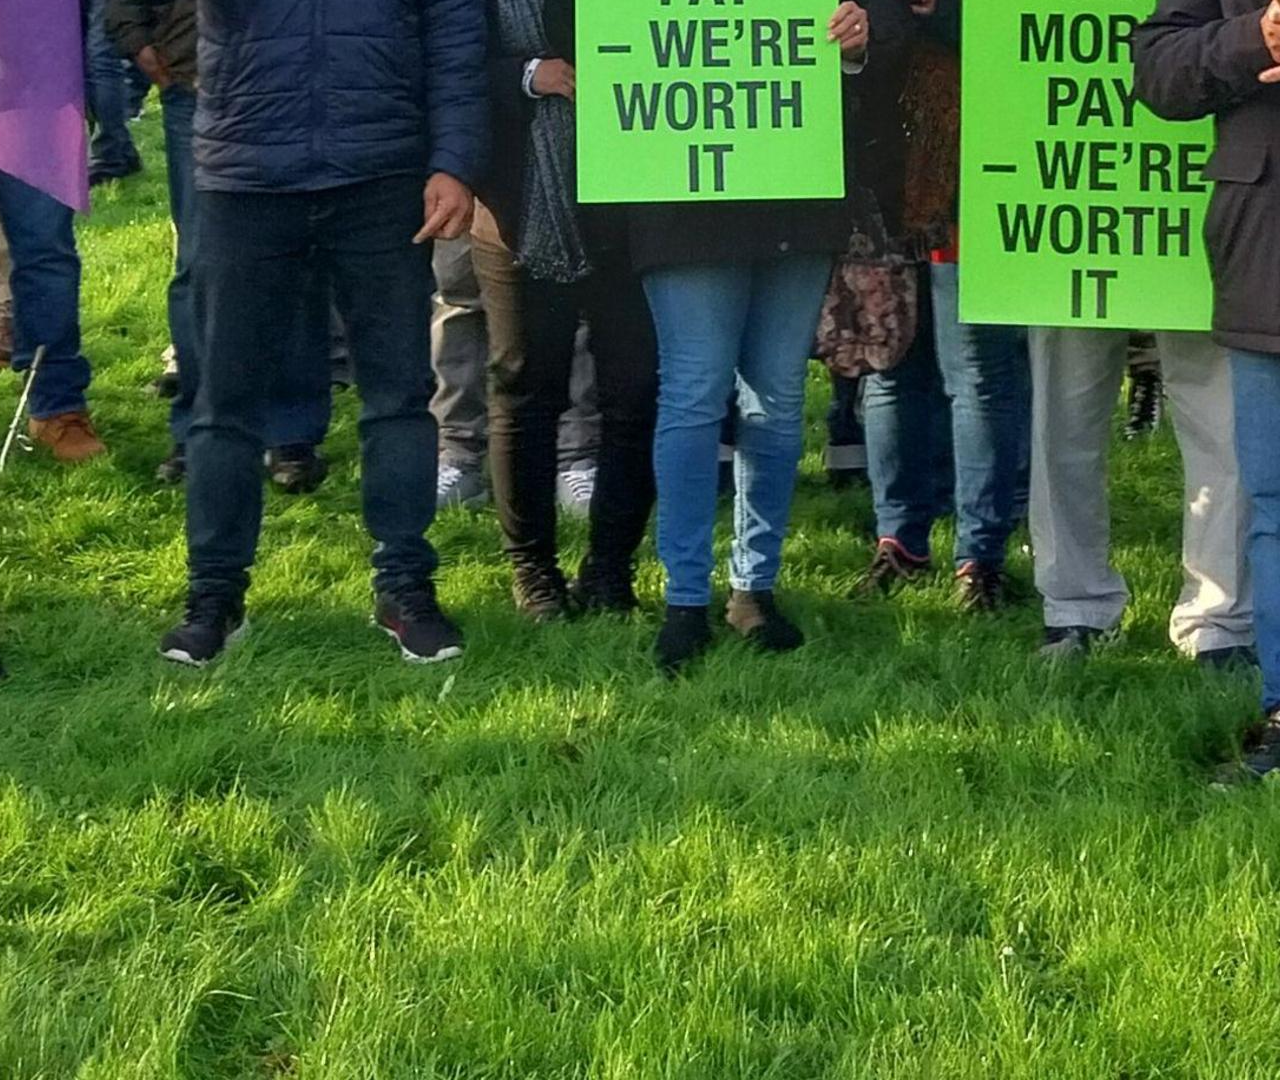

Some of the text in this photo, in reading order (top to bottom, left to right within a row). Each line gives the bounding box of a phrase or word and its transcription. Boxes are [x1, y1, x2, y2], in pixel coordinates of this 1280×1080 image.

[650, 19, 817, 68] WE'RE
[1020, 13, 1140, 64] MOR
[613, 81, 803, 131] WORTH
[1048, 77, 1136, 128] PAY
[689, 144, 734, 193] IT
[1035, 141, 1208, 193] WE'RE
[998, 203, 1191, 257] WORTH
[1071, 269, 1118, 319] IT
